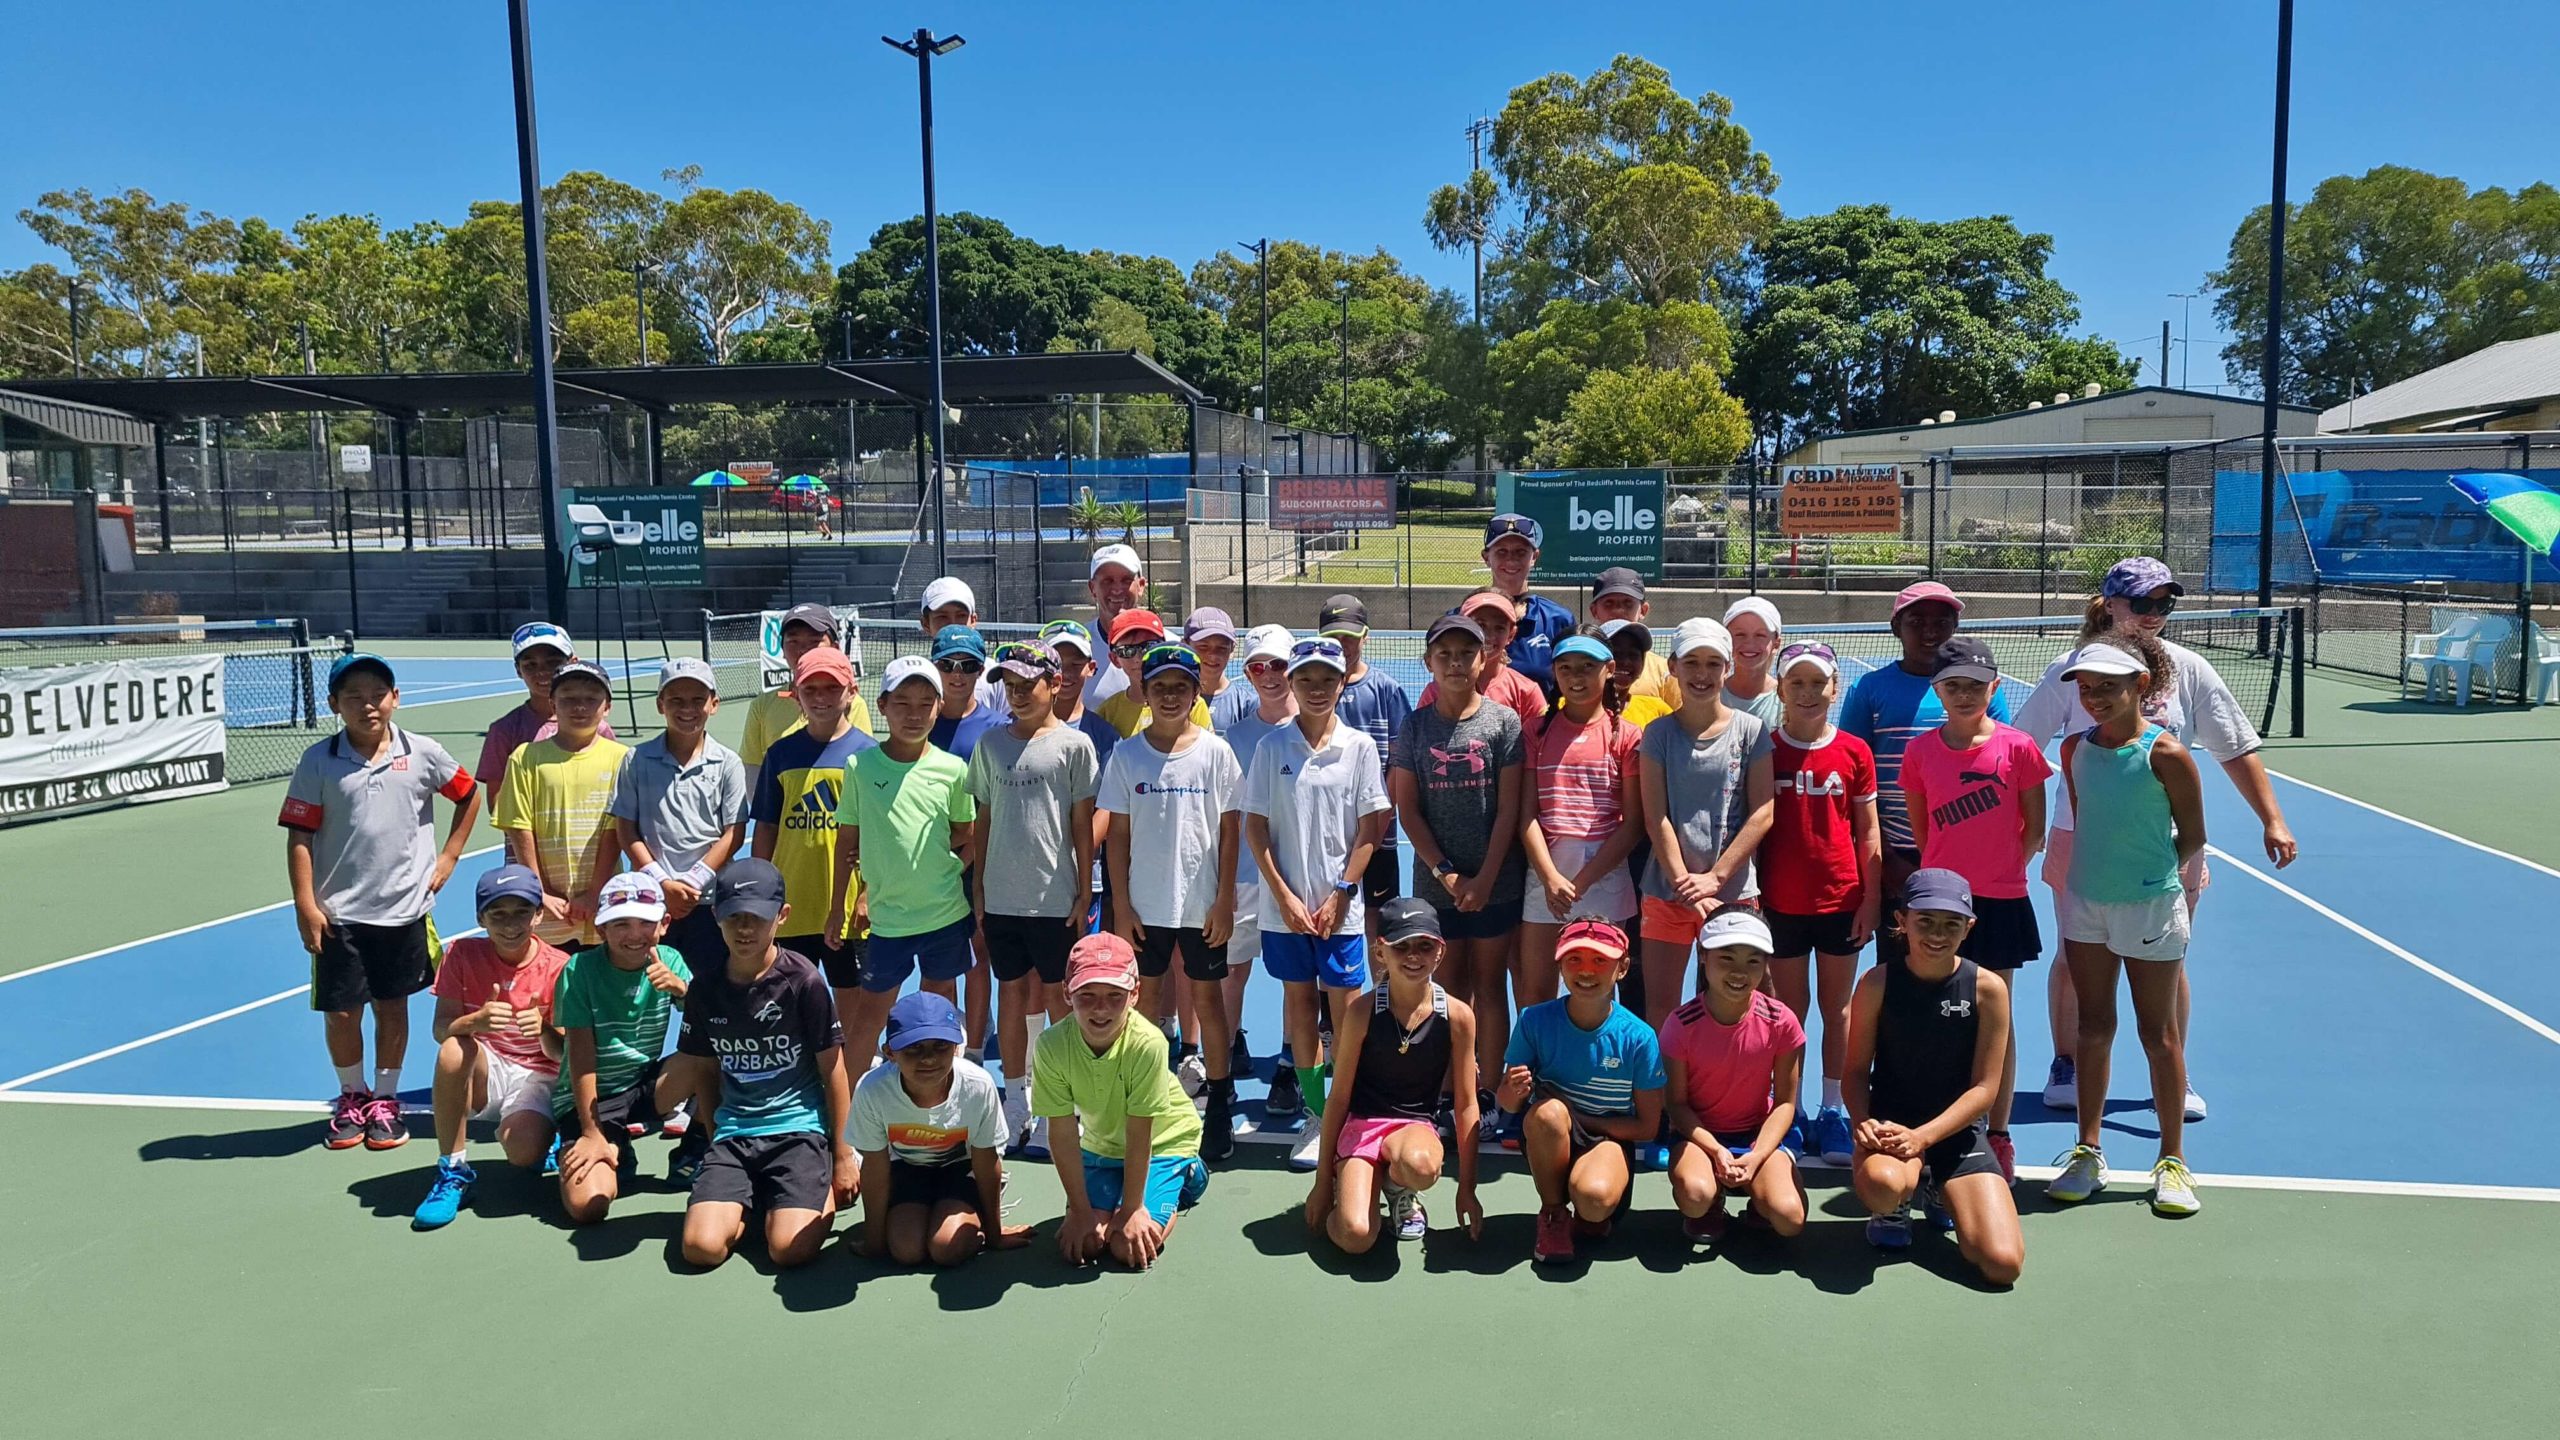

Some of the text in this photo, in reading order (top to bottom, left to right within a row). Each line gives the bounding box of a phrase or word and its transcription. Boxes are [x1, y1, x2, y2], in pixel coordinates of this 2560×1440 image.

[1540, 480, 1564, 488] Sponsor
[1789, 470, 1834, 484] CBD
[1279, 480, 1386, 497] BRISBANE
[1280, 500, 1372, 509] SUBCONTRACTORS
[1788, 495, 1895, 507] 0416 125 195
[1570, 495, 1656, 531] belle
[1788, 510, 1804, 518] Roof
[1807, 509, 1854, 518] Restorations
[1863, 508, 1895, 517] Painting
[1599, 536, 1655, 545] PROPERTY
[650, 546, 698, 555] PROPERTY
[0, 673, 216, 738] BELVEDERE
[45, 781, 77, 807] AVE
[165, 760, 209, 785] POINT
[1135, 782, 1209, 797] Champion
[1774, 770, 1844, 795] FILA
[1932, 785, 2000, 831] PUMA
[785, 812, 840, 830] adida
[762, 1034, 790, 1048] TO
[717, 1043, 802, 1071] RISBANE
